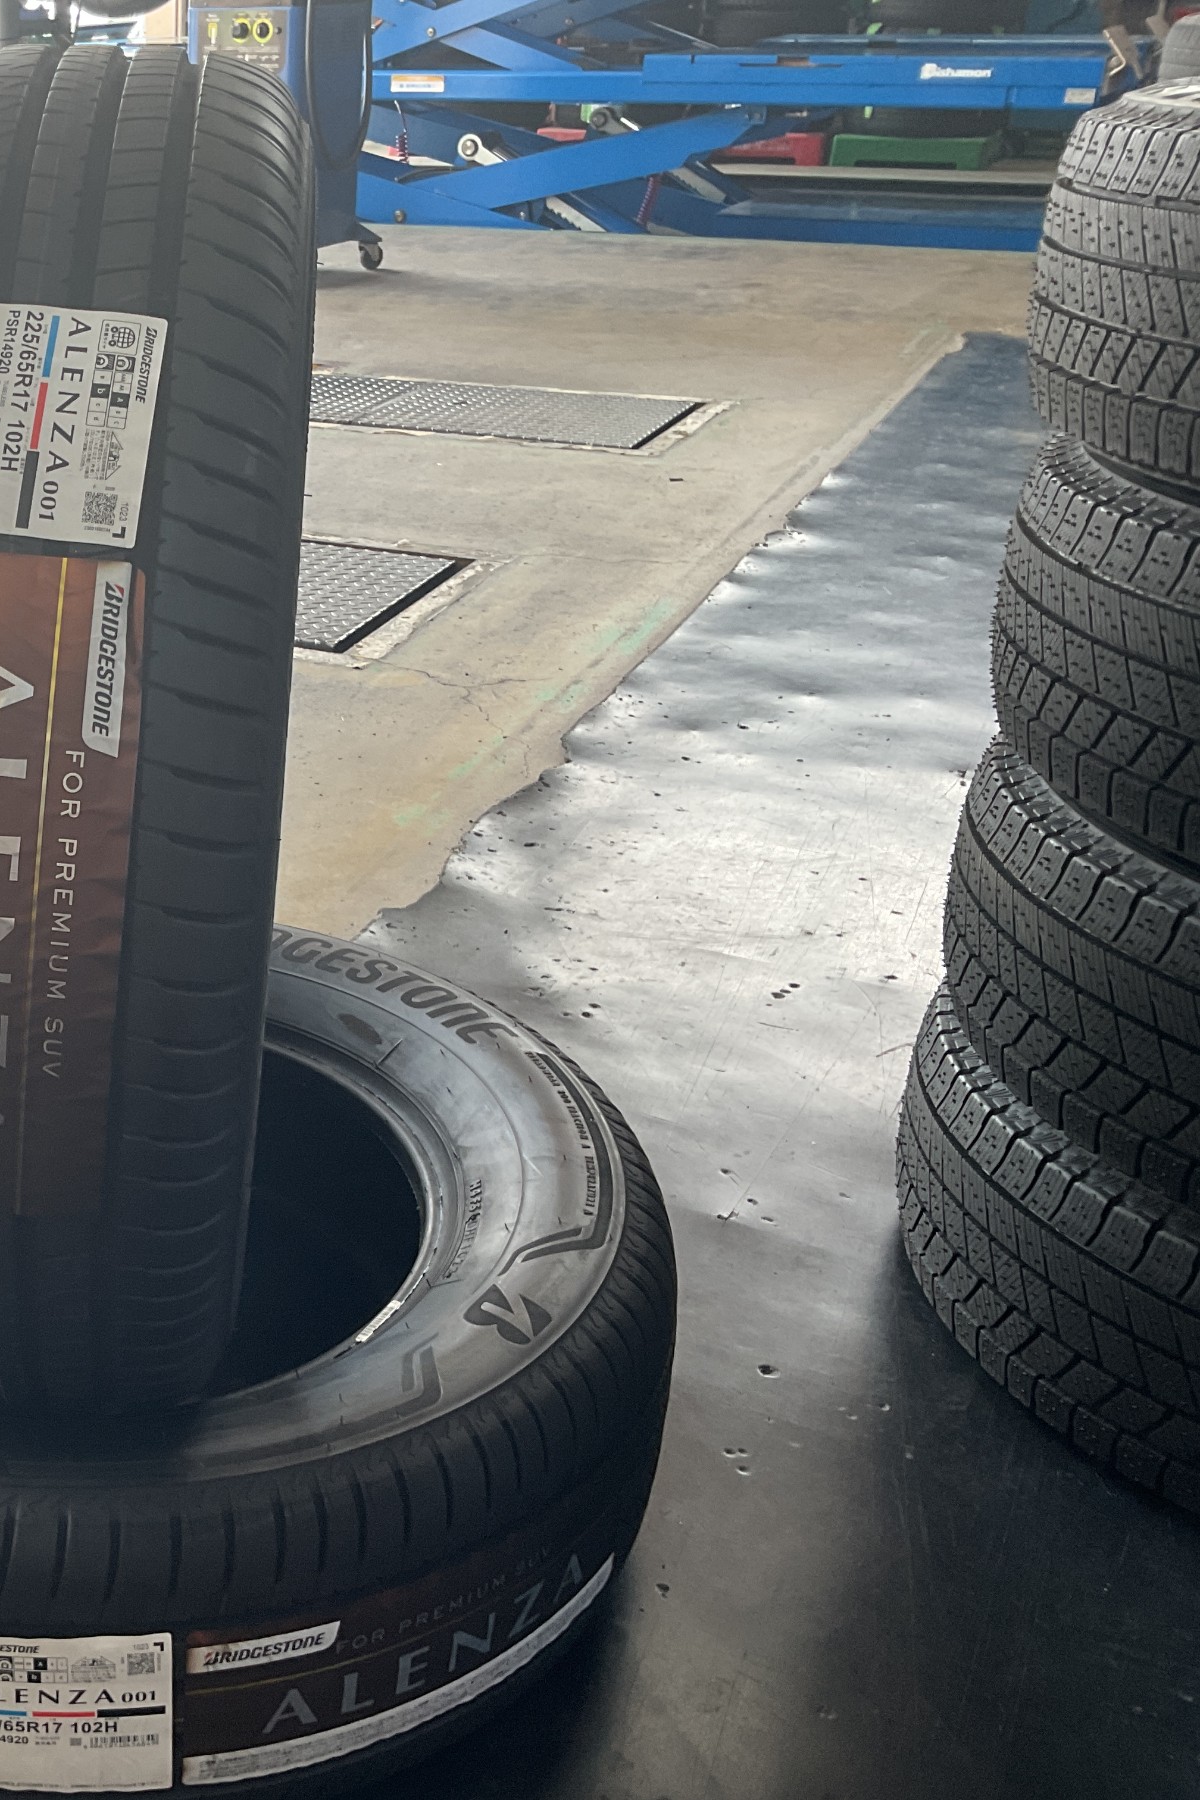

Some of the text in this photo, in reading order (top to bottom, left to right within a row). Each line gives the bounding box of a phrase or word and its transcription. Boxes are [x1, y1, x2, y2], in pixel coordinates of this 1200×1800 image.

[12, 310, 44, 412] 225/65R17
[96, 387, 105, 395] b
[135, 326, 158, 403] BRIDGESTONE
[0, 419, 25, 472] 102H
[39, 317, 92, 521] ALENZA 001
[119, 502, 129, 522] 1023
[92, 581, 124, 737] BRIDGESTONE
[41, 750, 85, 1080] FOR PREMIUM SUV
[202, 1632, 325, 1667] BRIDGESTONE
[262, 1553, 583, 1735] ALENZA
[336, 1628, 385, 1655] FOR
[399, 1574, 506, 1634] PREMIUM
[70, 1721, 118, 1734] 102H
[121, 1690, 157, 1703] 001
